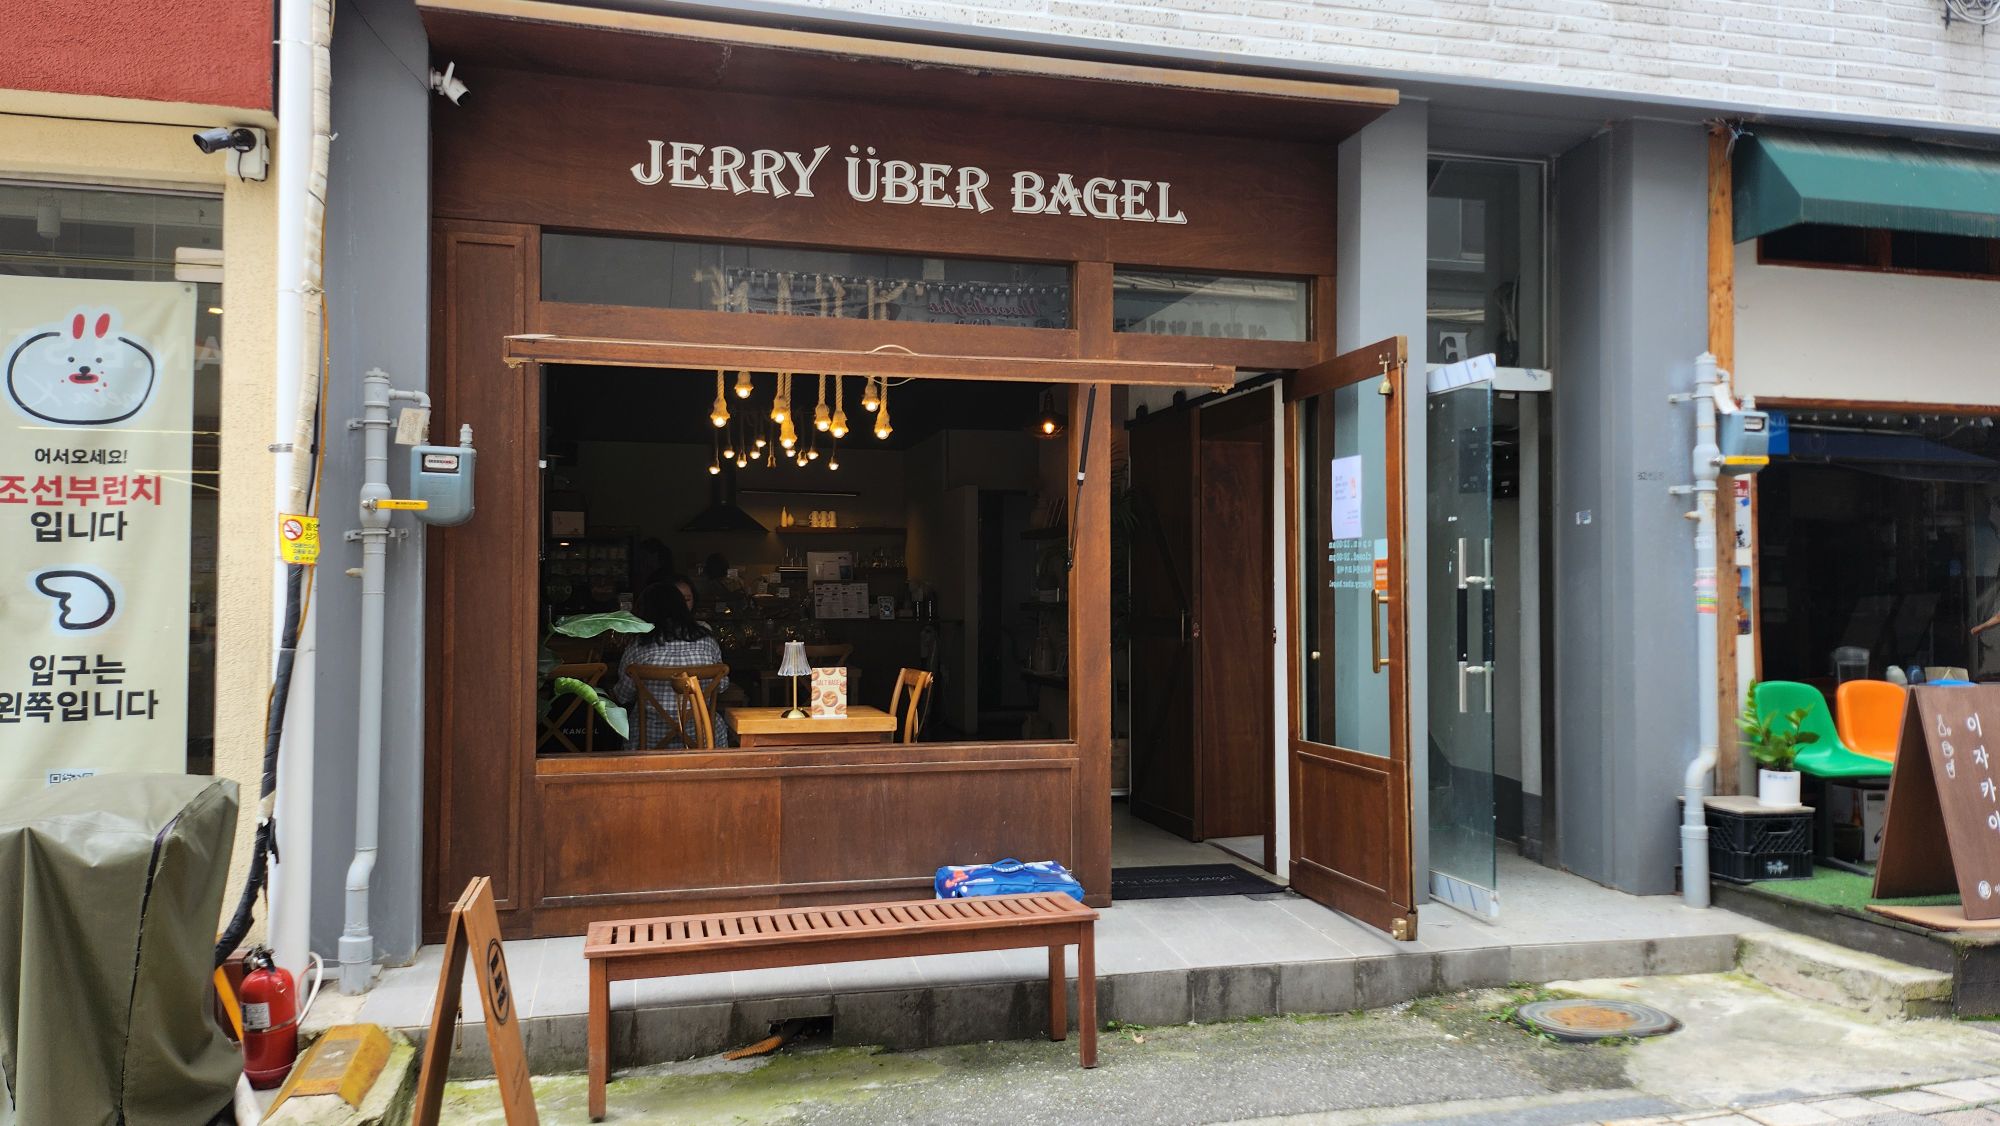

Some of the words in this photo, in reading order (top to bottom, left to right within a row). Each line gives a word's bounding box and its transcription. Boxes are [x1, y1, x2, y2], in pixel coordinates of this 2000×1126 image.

[630, 139, 831, 199] JERRY
[844, 144, 994, 214] ÜBER
[1010, 171, 1188, 225] BAGEL
[34, 448, 128, 465] 어서오세요!
[0, 474, 162, 506] 조선부런치
[30, 510, 129, 542] 입니다
[29, 654, 126, 686] 입구는
[0, 689, 160, 723] 왼쪽입니다
